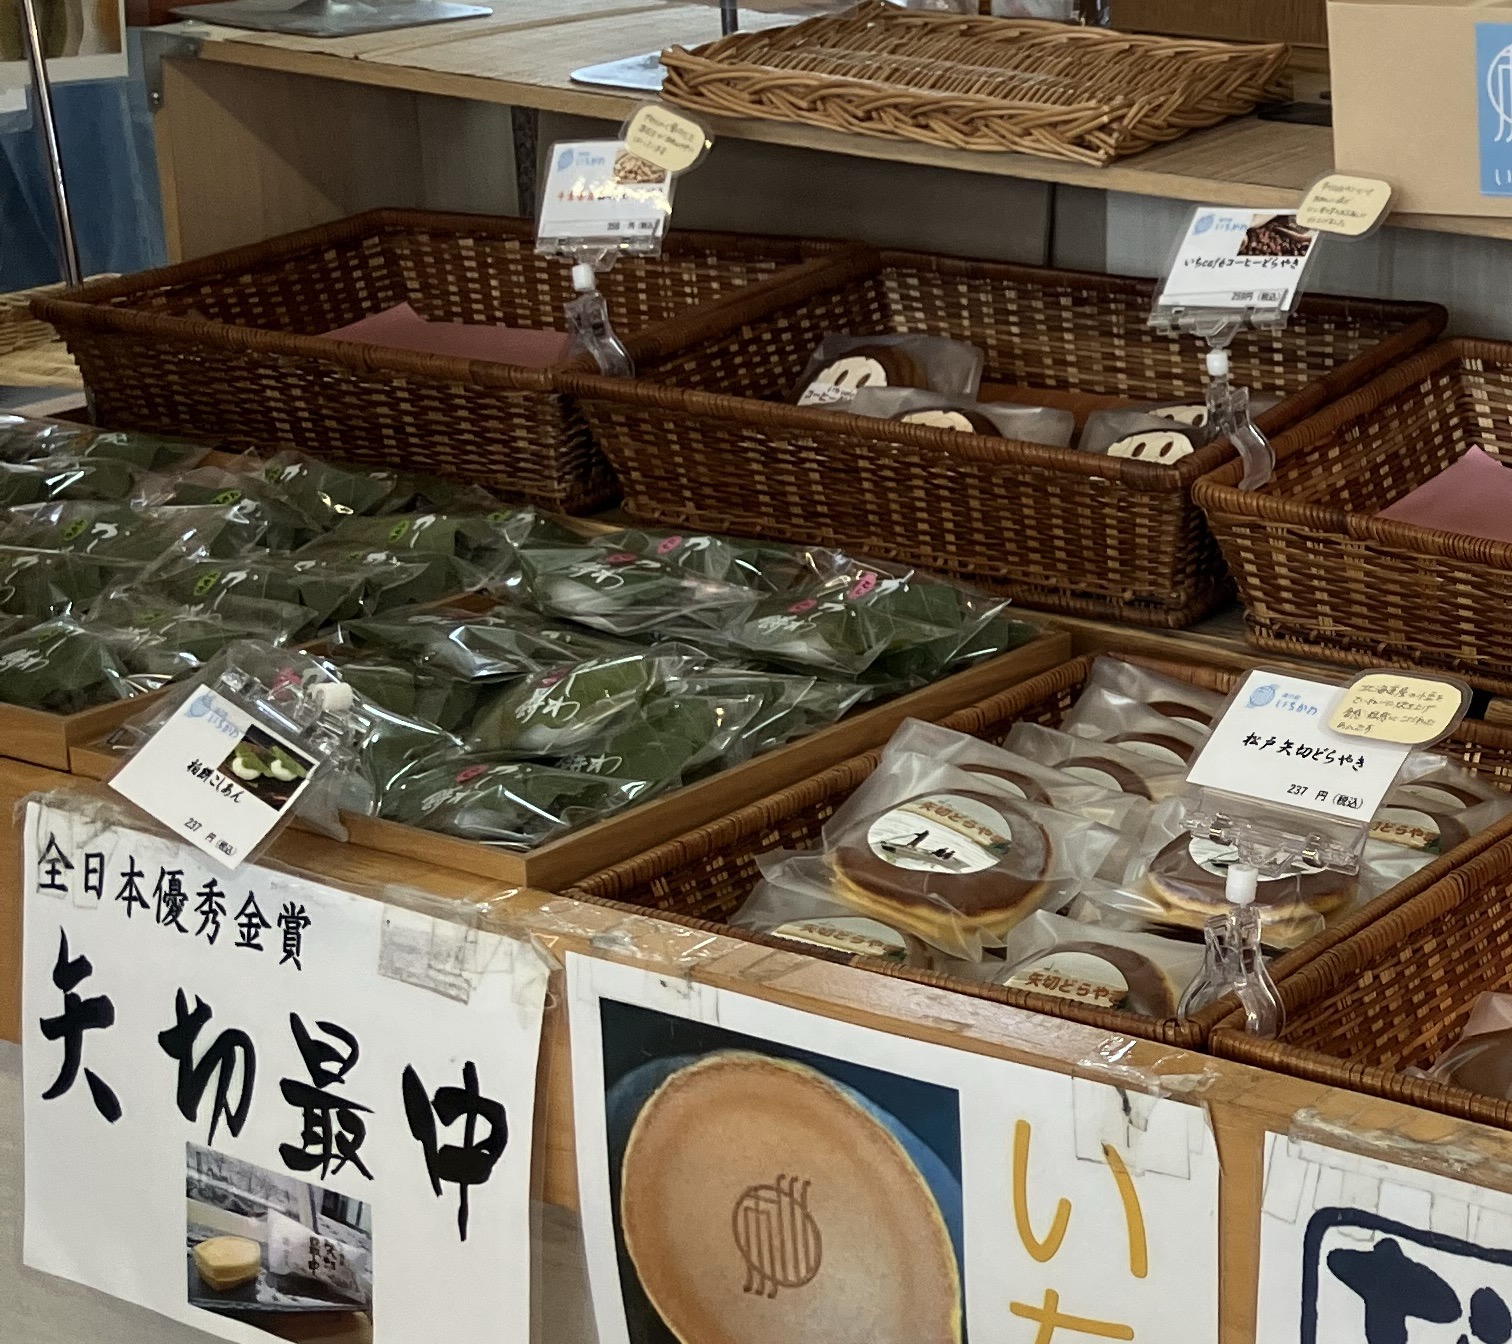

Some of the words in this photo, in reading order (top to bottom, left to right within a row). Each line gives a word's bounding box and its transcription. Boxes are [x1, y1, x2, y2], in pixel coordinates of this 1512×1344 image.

[1241, 731, 1365, 771] 松戸矢切どらやき
[1287, 783, 1309, 796] 237
[1315, 790, 1329, 802] 円
[1332, 793, 1365, 810] (税込)
[184, 816, 203, 833] 237
[37, 833, 312, 971] 全日本優秀金賞
[39, 925, 510, 1243] 矢切最中
